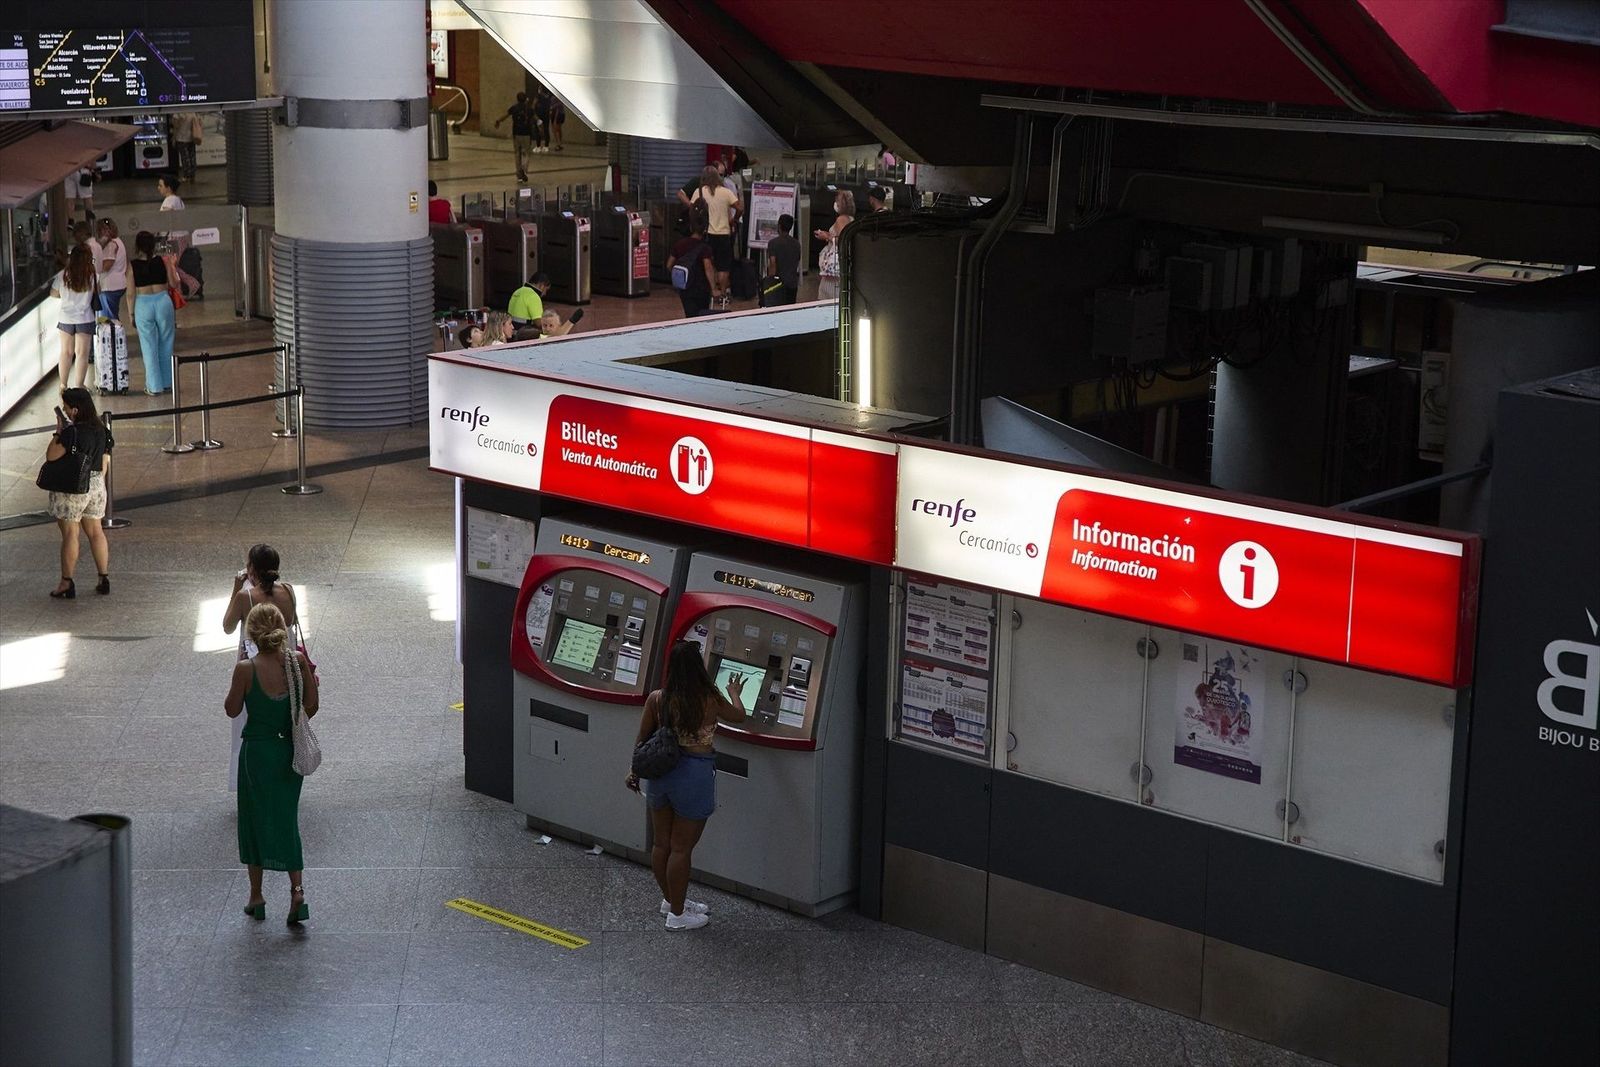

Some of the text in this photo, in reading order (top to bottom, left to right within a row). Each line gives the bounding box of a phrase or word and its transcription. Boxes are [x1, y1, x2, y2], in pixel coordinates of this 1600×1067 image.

[440, 405, 490, 432] renfe
[476, 432, 525, 456] Cercanías
[560, 422, 618, 450] Billetes
[560, 448, 658, 480] Venta Automática
[912, 496, 977, 528] renfe
[560, 534, 590, 550] 14:19
[958, 529, 1023, 557] Cercanías
[1072, 518, 1196, 563] Información
[1070, 548, 1158, 581] Information
[722, 572, 756, 589] 14:19
[1212, 678, 1229, 693] 25
[1538, 726, 1584, 749] BIJOU
